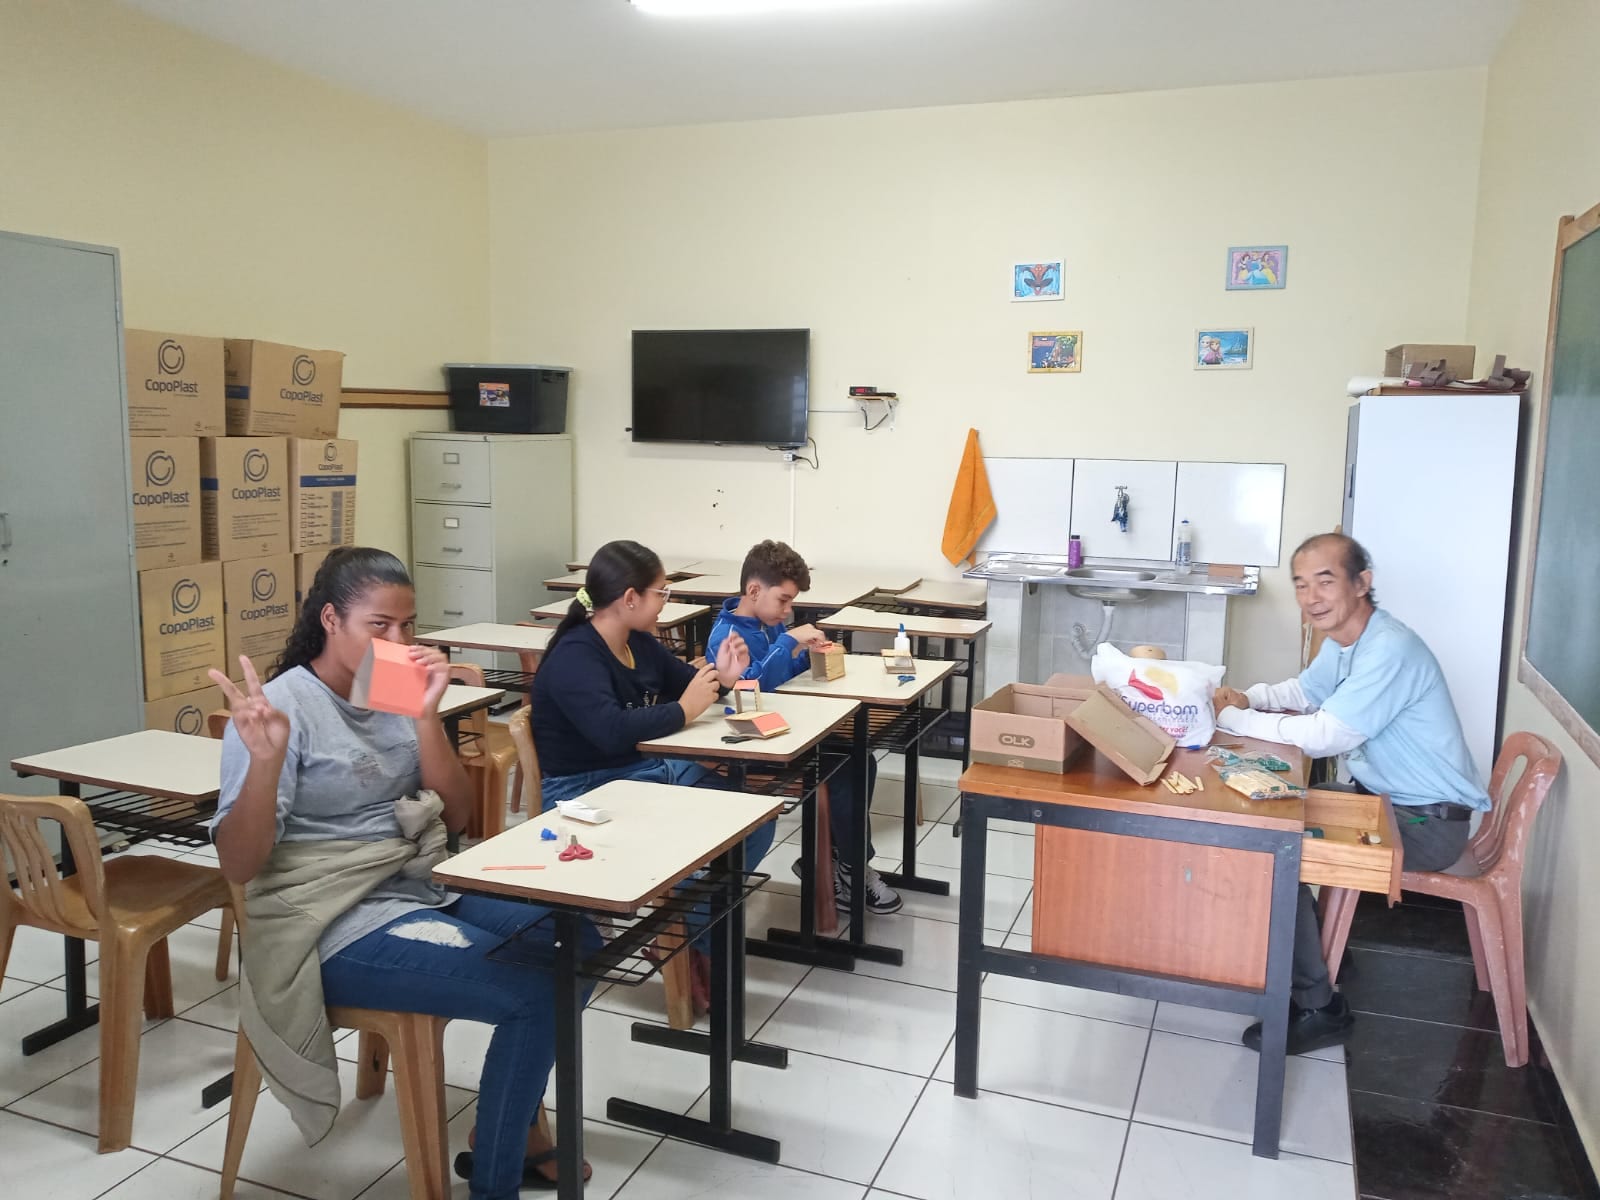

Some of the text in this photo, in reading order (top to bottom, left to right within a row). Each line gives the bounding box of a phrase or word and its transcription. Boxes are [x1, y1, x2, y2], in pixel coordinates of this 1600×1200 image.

[145, 379, 199, 393] CopoPlast
[280, 388, 324, 403] CopoPlast
[132, 491, 189, 506] CopoPlast
[232, 487, 281, 500] CopoPlast
[240, 604, 289, 621] CopoPlast
[160, 616, 215, 635] CopoPlast
[1001, 735, 1031, 746] OLK
